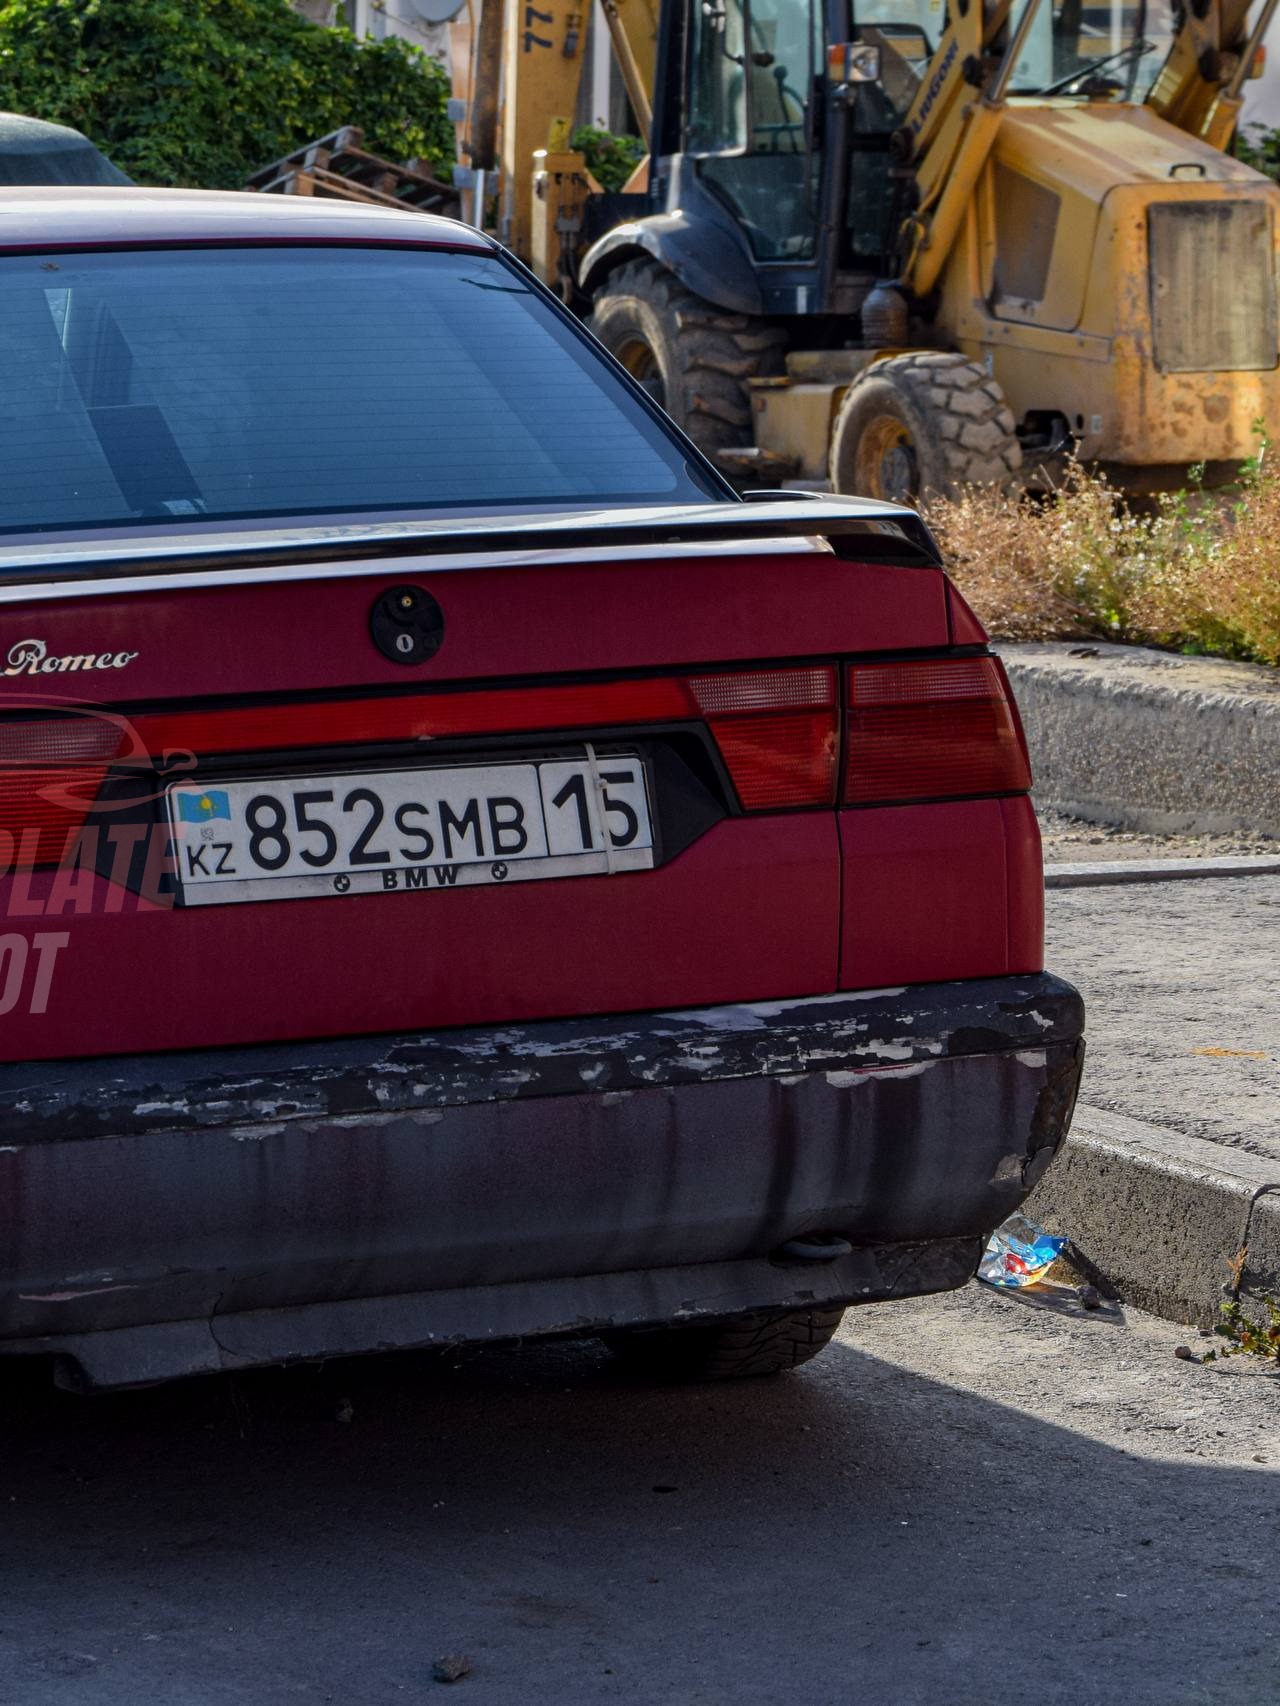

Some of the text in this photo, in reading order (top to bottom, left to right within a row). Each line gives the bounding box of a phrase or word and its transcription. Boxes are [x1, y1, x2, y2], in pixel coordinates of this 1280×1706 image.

[523, 0, 553, 53] 77
[4, 638, 139, 676] Romeo
[186, 843, 236, 877] KZ
[552, 771, 639, 850] 15
[382, 866, 458, 890] BMW
